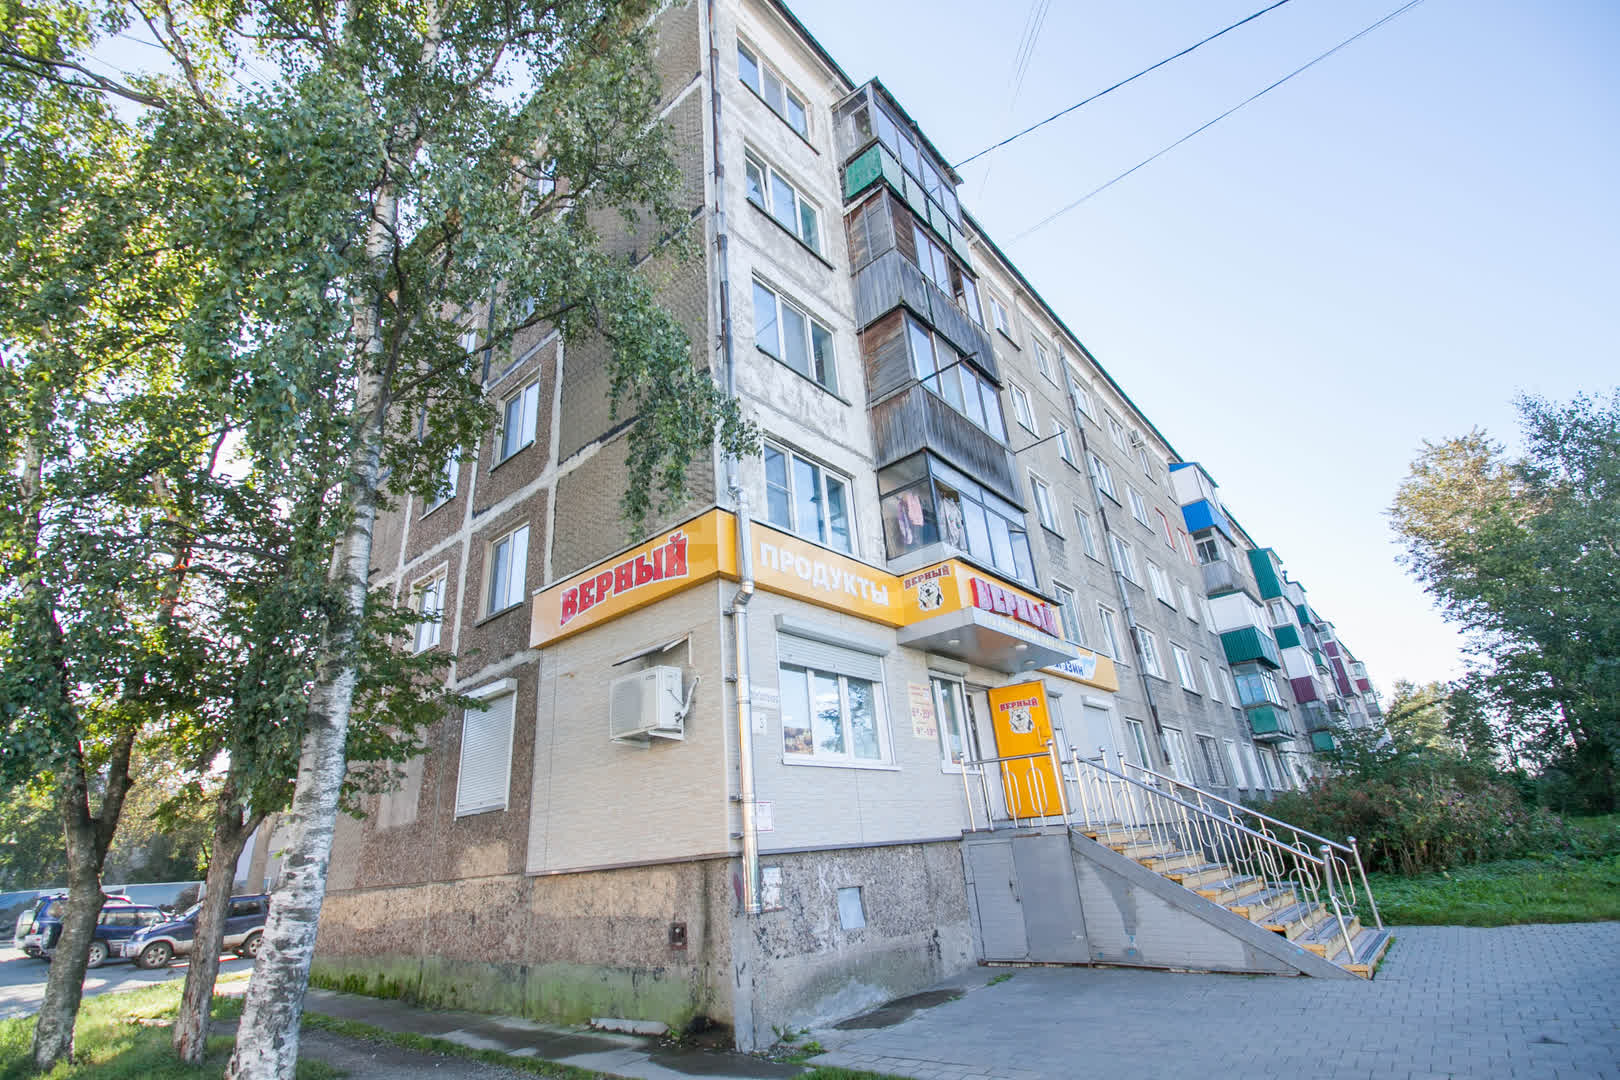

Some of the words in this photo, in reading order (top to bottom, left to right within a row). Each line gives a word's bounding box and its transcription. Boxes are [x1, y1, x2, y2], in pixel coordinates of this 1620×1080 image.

[560, 530, 688, 627] ВЕРНЫЙ
[760, 541, 889, 606] ПРОДУКТЫ
[903, 564, 950, 590] ВЕРНЫЙ
[998, 696, 1039, 712] ВЕРНЫЙ
